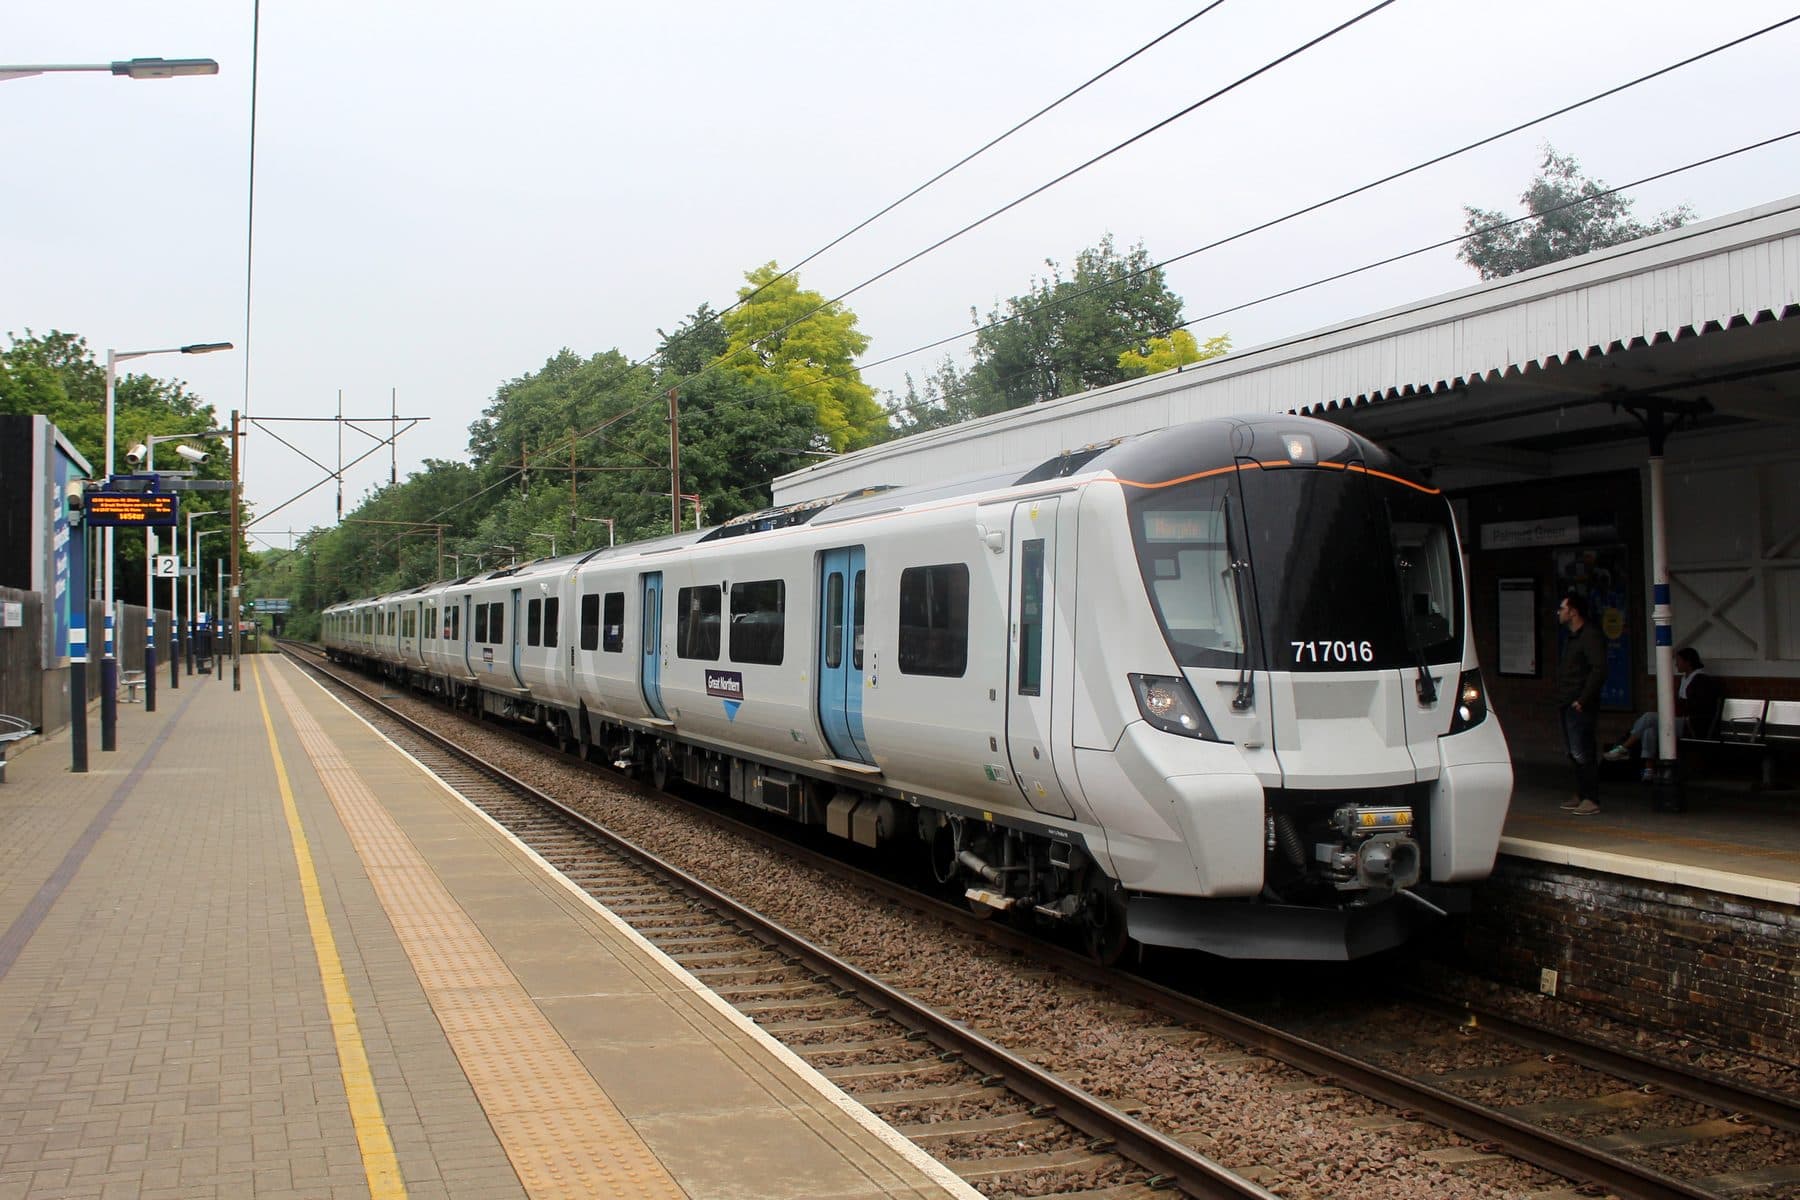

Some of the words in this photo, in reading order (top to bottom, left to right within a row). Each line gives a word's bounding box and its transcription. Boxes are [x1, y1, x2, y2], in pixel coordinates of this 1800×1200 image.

[163, 559, 174, 574] 2
[1291, 641, 1374, 662] 717016
[708, 674, 720, 689] Great
[720, 676, 740, 692] Northern
